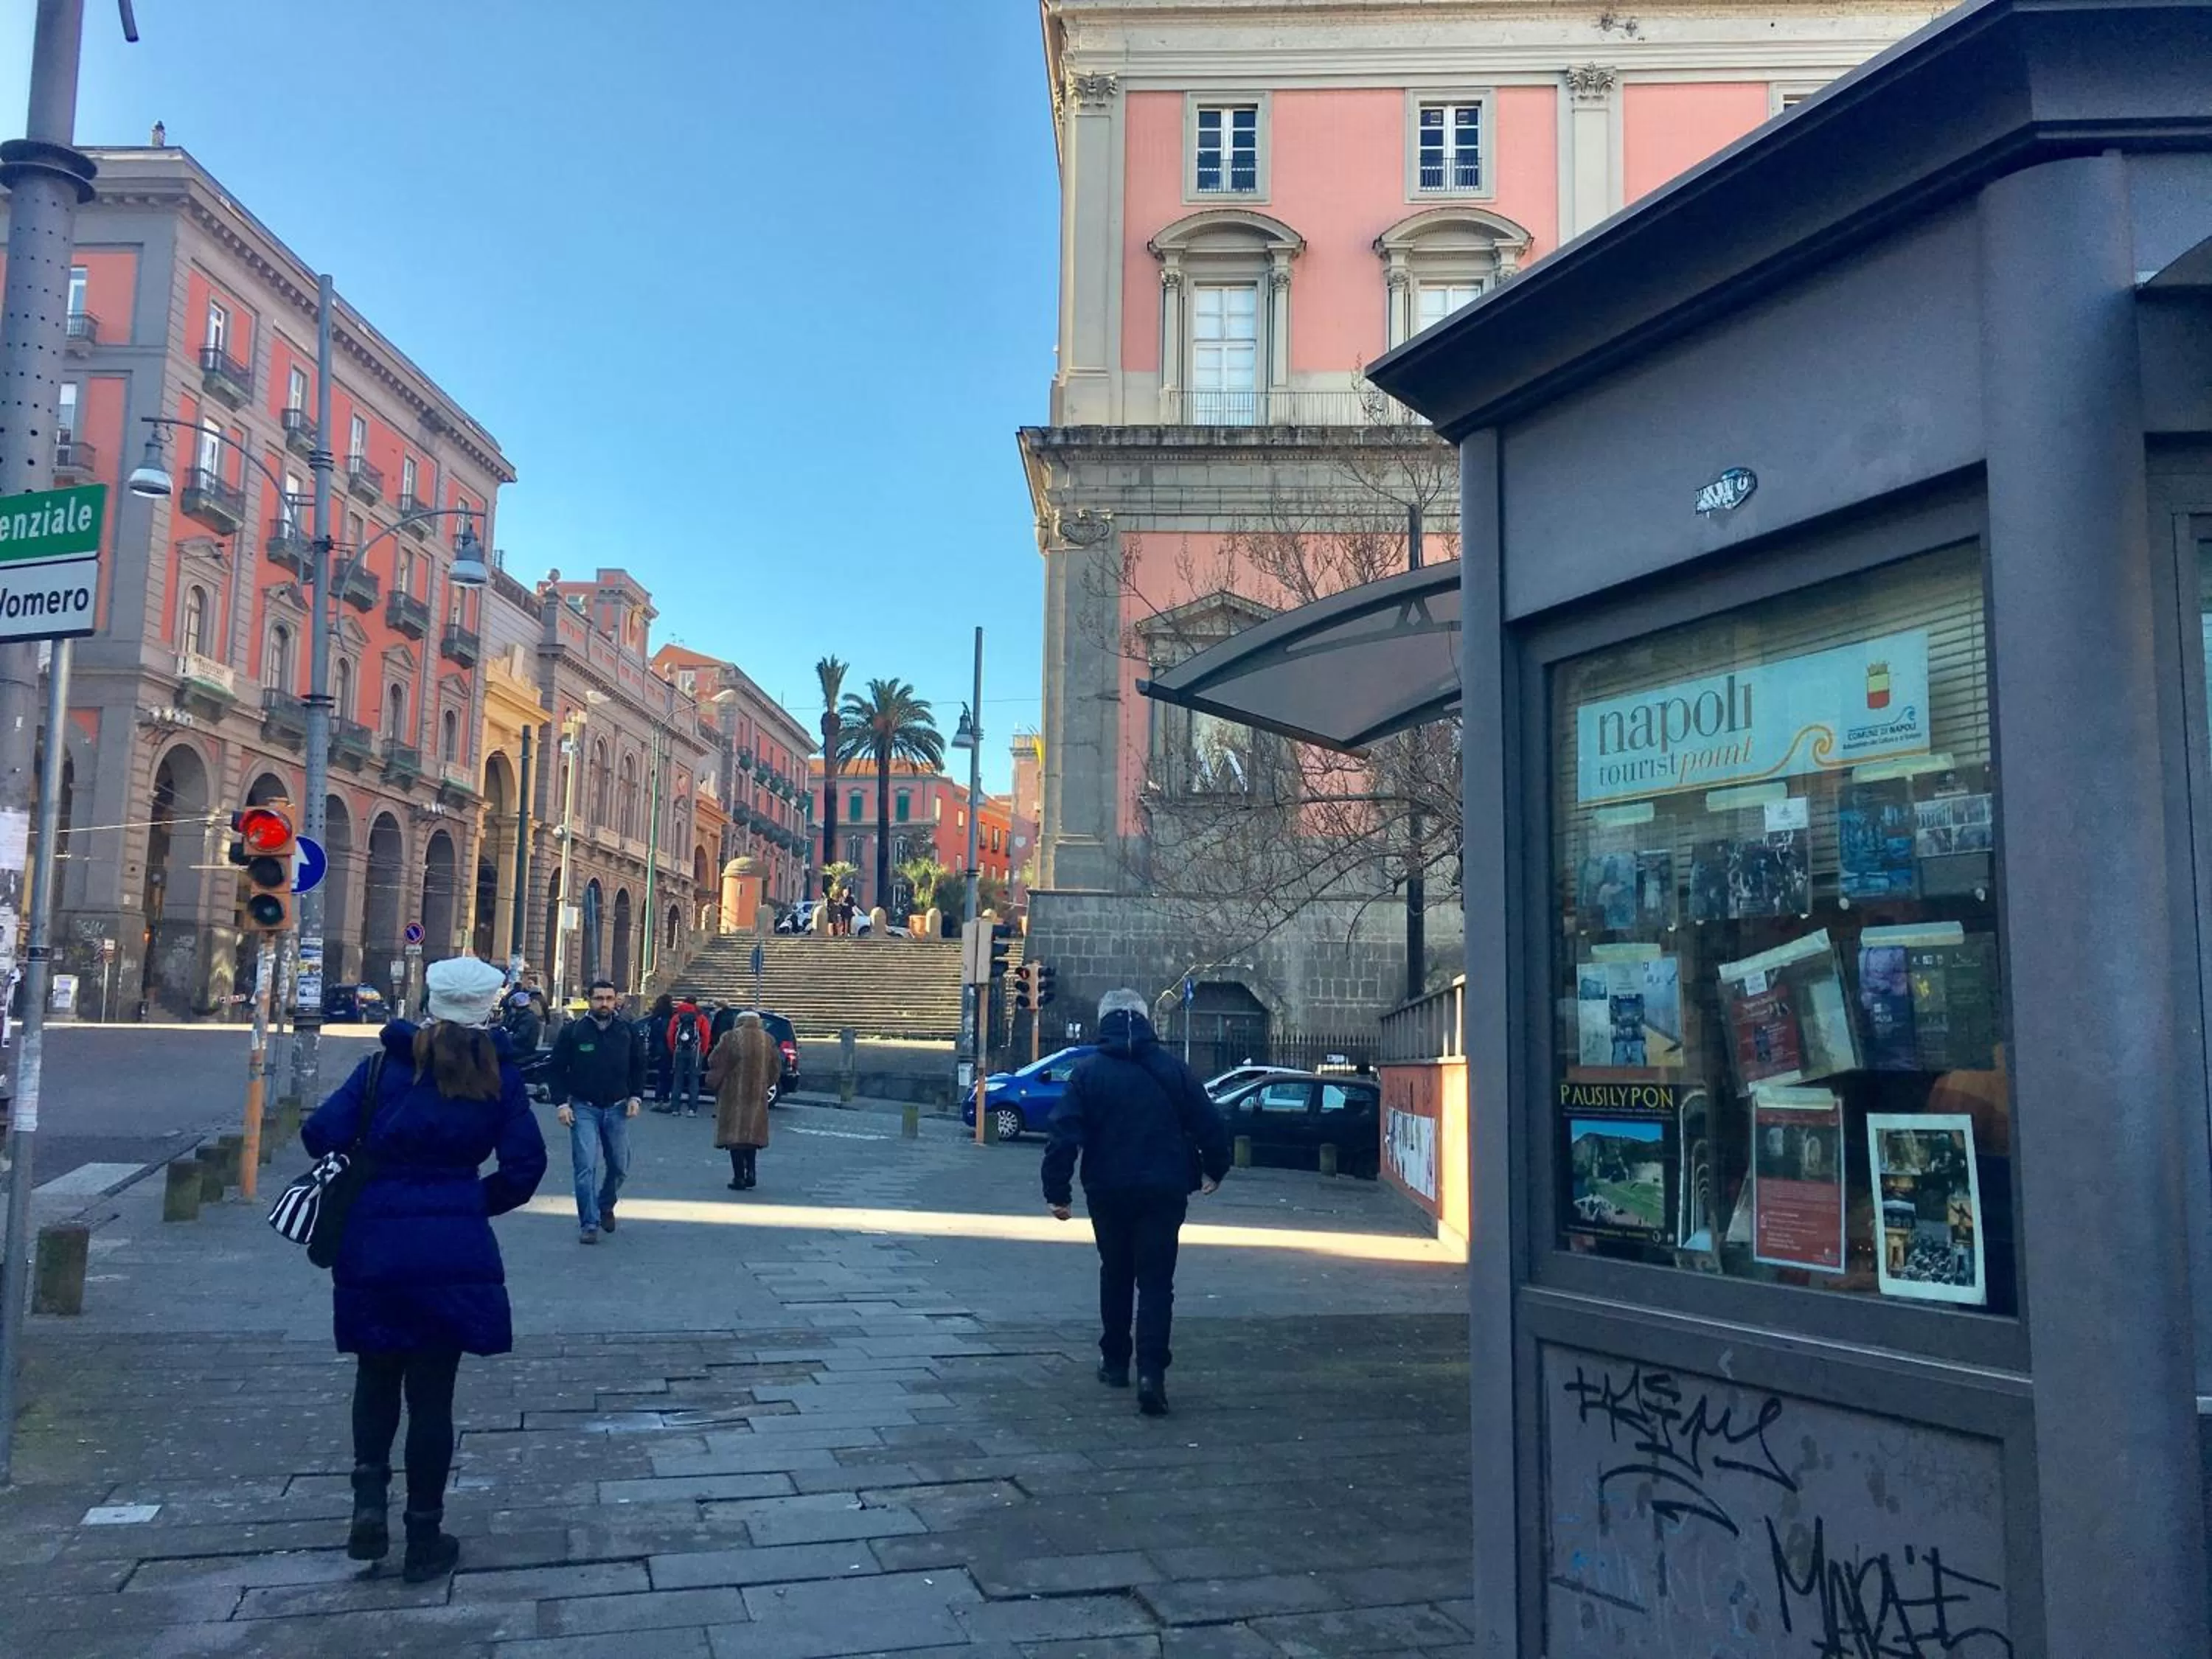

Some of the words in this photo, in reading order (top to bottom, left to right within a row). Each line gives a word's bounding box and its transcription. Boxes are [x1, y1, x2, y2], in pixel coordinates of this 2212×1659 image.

[0, 495, 93, 542] enziale
[1599, 675, 1753, 755] napoli
[1889, 722, 1916, 734] NAPOLI
[1560, 1084, 1674, 1107] PAUSILYPON
